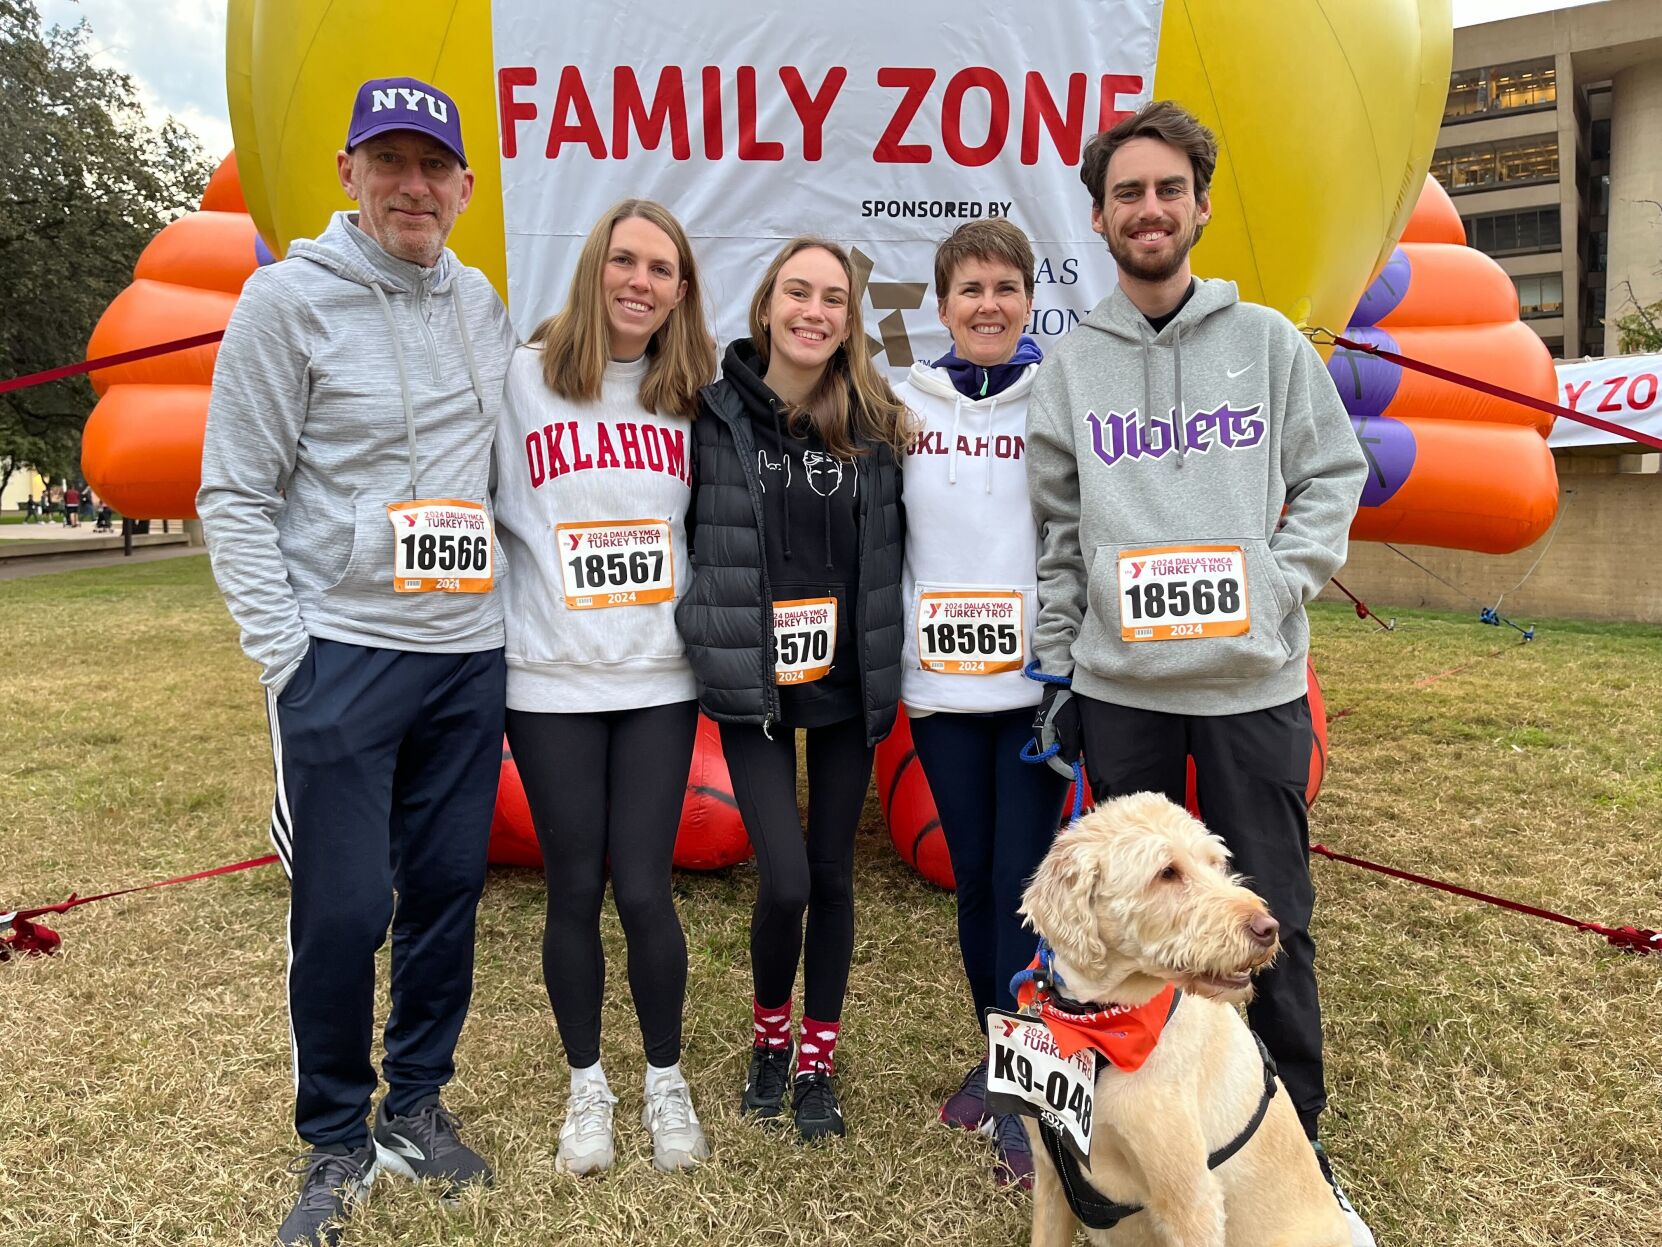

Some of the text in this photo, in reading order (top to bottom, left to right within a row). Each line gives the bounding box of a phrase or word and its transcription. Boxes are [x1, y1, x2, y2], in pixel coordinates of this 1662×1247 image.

[372, 87, 448, 124] NYU
[498, 65, 1144, 167] FAMILY ZONE
[861, 200, 1012, 218] SPONSORED BY
[1596, 373, 1659, 413] ZO
[1084, 400, 1268, 468] Violets
[445, 511, 467, 520] DALLAS
[467, 513, 484, 521] YMCA
[425, 518, 485, 530] TURKEY TROT
[587, 531, 608, 540] 2024
[610, 530, 638, 538] DALLAS
[587, 535, 661, 549] TURKEY TROT
[401, 533, 488, 571] 18566
[568, 550, 664, 589] 18567
[1151, 560, 1173, 568] 2024
[1151, 563, 1233, 577] TURKEY TROT
[436, 578, 460, 589] 2024
[608, 591, 637, 604] 2024
[1125, 578, 1240, 619] 18568
[785, 610, 808, 619] DALLAS
[809, 608, 828, 616] YMCA
[804, 615, 828, 626] TROT
[944, 609, 1013, 618] TURKEY TROT
[1170, 624, 1203, 636] 2024
[922, 623, 1017, 655] 18565
[958, 661, 985, 671] 2024
[778, 671, 804, 682] 2024
[1024, 1026, 1050, 1042] 2024
[995, 1044, 1092, 1138] K9-048
